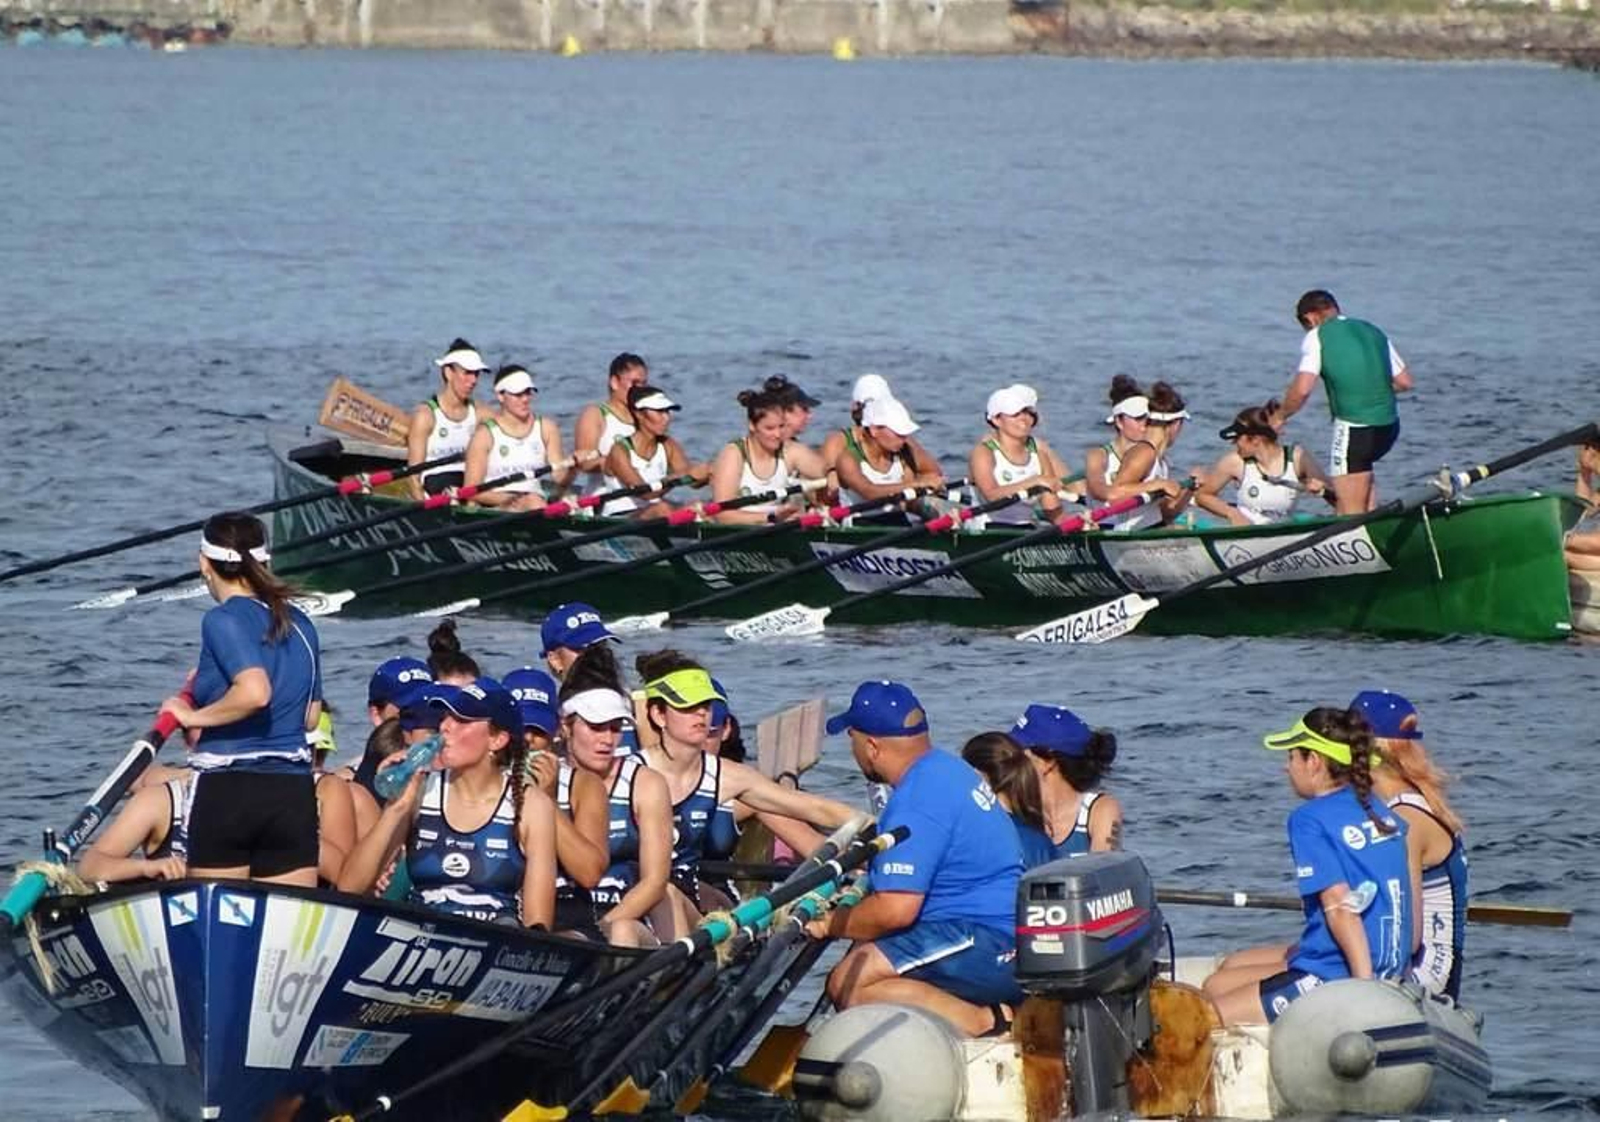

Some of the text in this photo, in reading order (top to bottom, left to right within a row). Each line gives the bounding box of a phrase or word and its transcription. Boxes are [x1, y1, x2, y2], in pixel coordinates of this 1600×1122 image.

[1043, 600, 1127, 643] FRIGALSA
[1027, 905, 1067, 927] 20
[1086, 889, 1134, 921] YAMAHA
[121, 947, 174, 1035] lgt
[266, 949, 329, 1038] lgt
